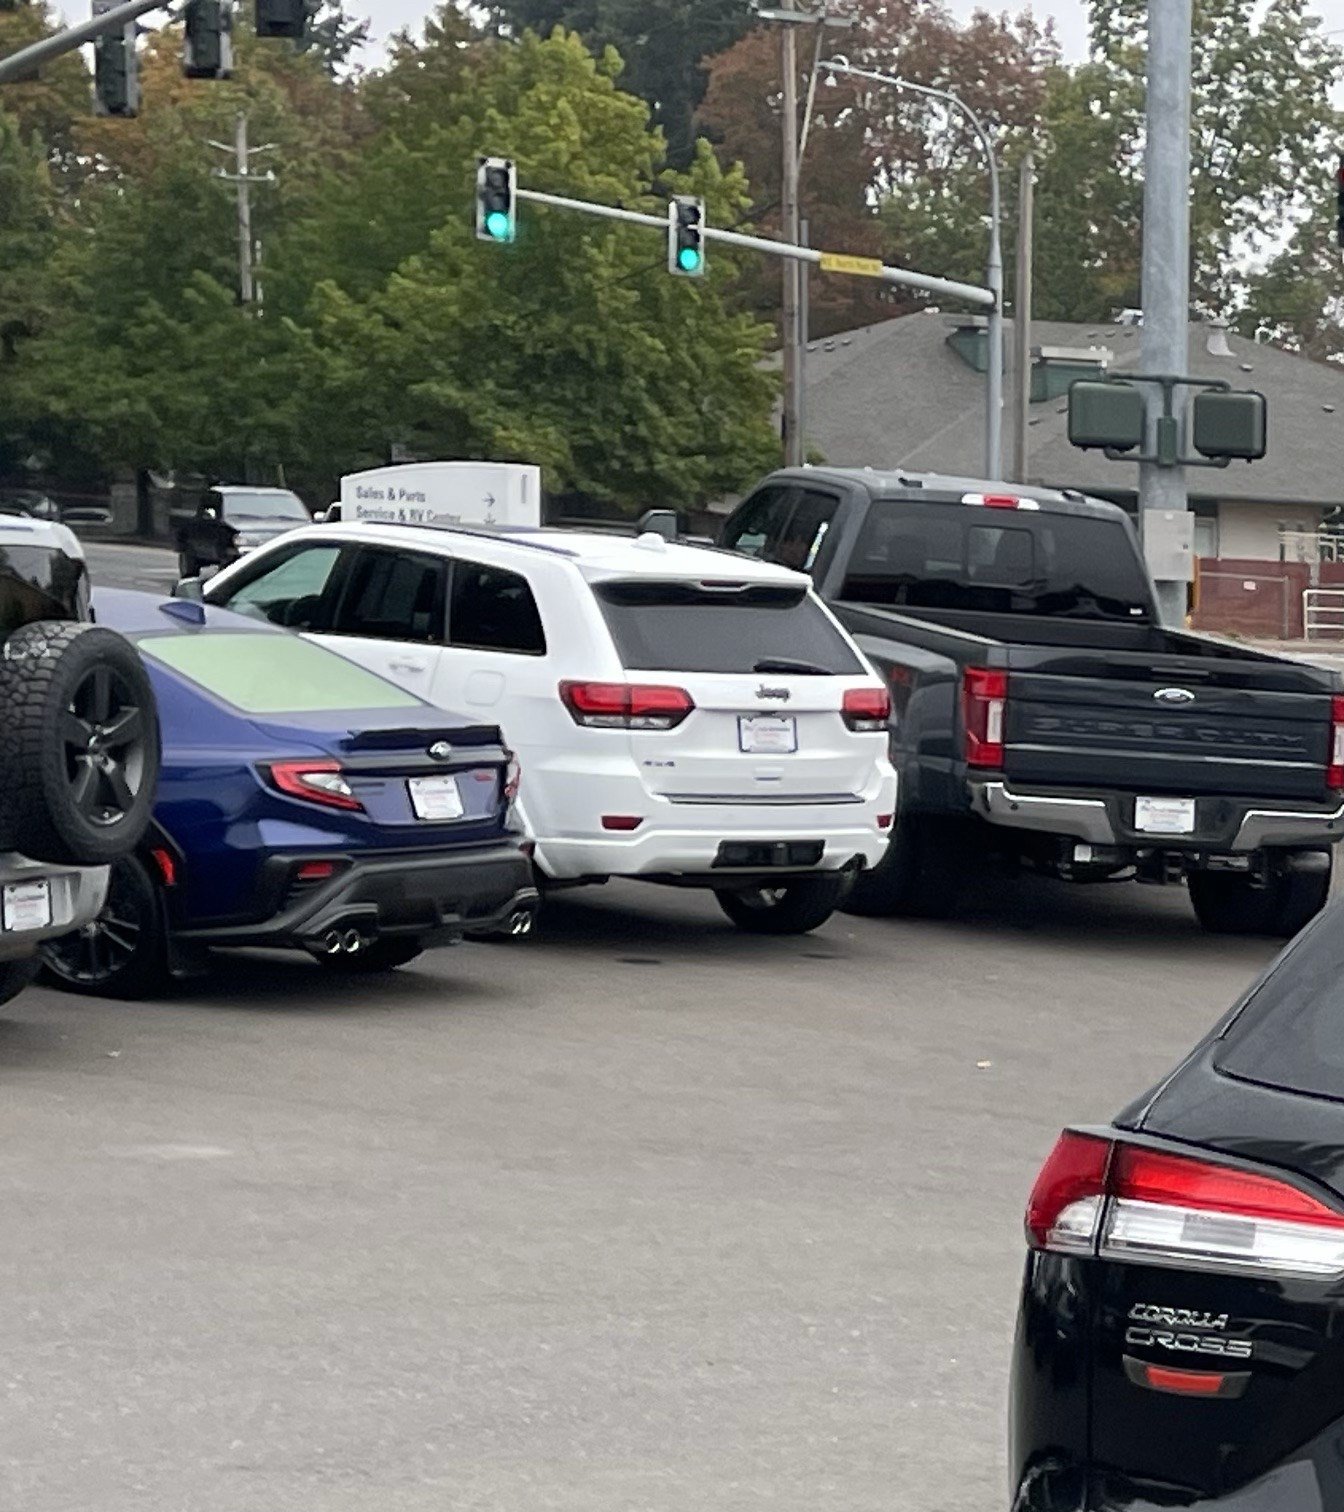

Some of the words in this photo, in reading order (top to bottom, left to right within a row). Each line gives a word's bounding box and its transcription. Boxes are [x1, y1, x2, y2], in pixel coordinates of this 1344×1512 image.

[356, 485, 385, 500] Sales
[1127, 1303, 1229, 1330] COROLLA
[1125, 1326, 1253, 1359] CROSS
